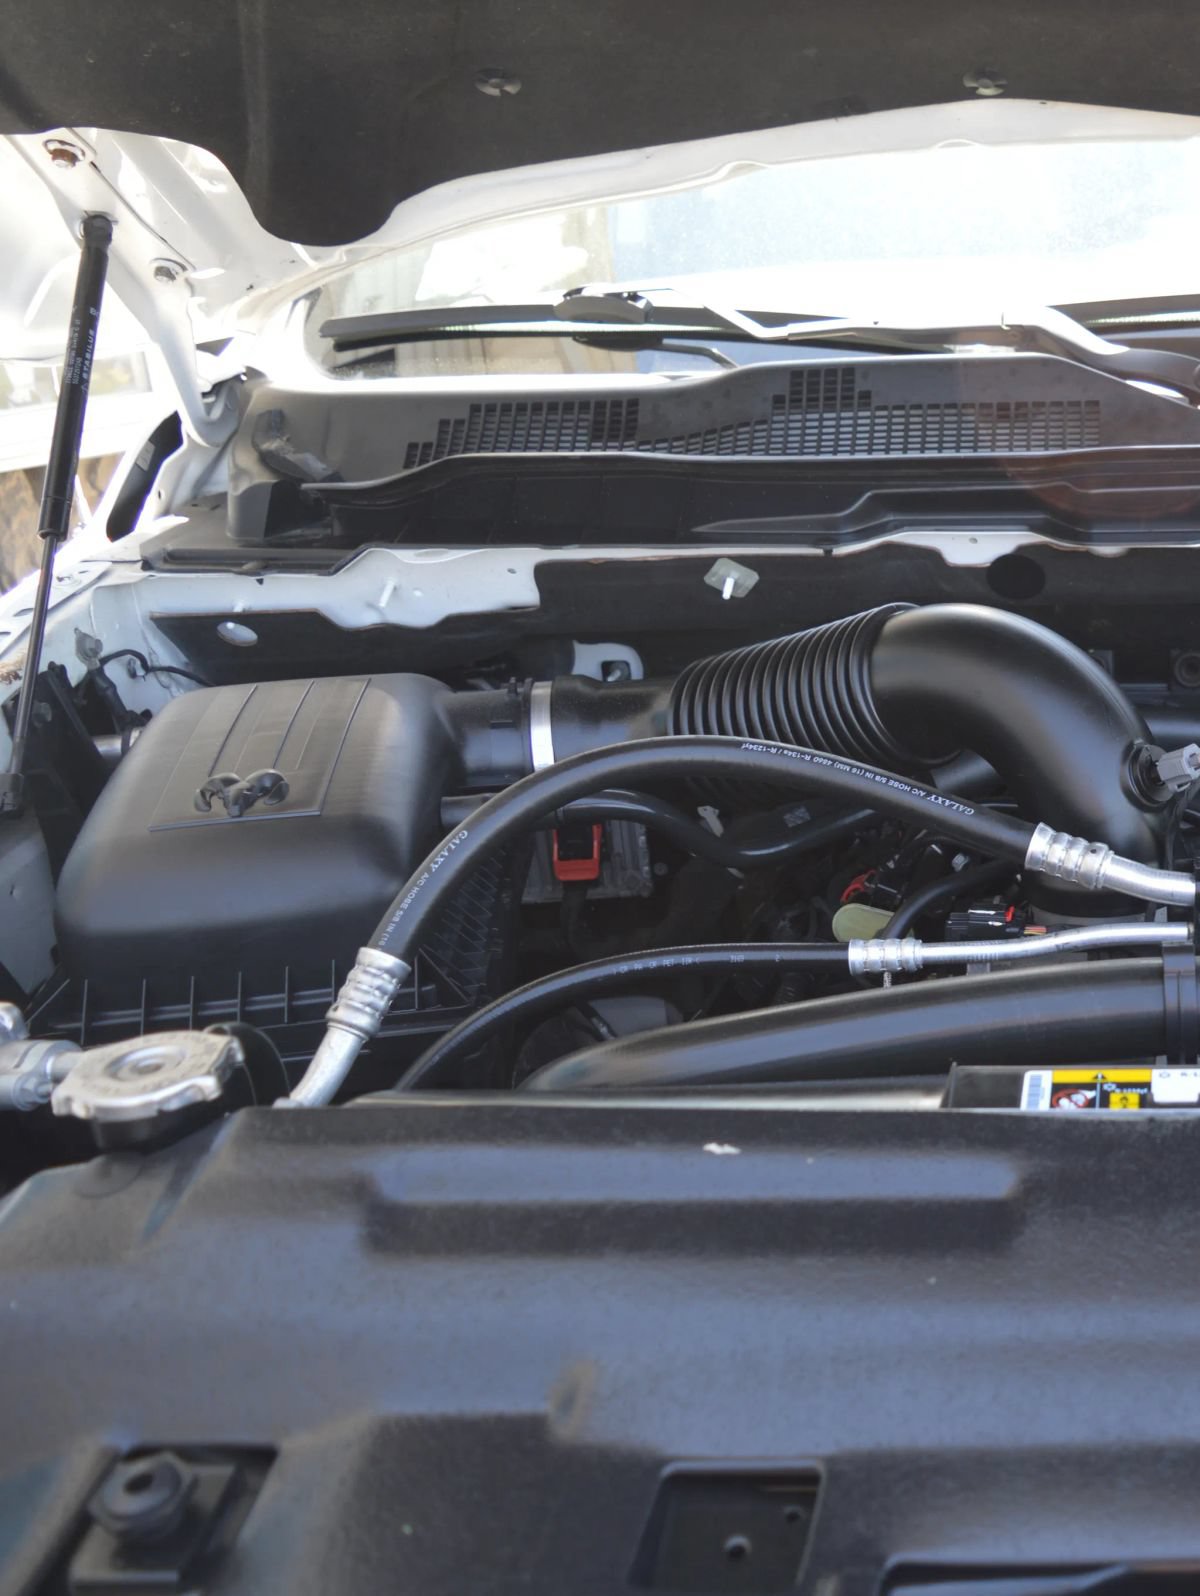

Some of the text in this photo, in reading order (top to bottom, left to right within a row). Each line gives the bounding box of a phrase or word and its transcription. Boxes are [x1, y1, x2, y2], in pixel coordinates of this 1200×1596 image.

[865, 771, 875, 781] IN
[888, 779, 911, 793] HOSE
[911, 787, 926, 798] A/C
[927, 793, 975, 816] GALAXY
[430, 830, 468, 873] GALAXY
